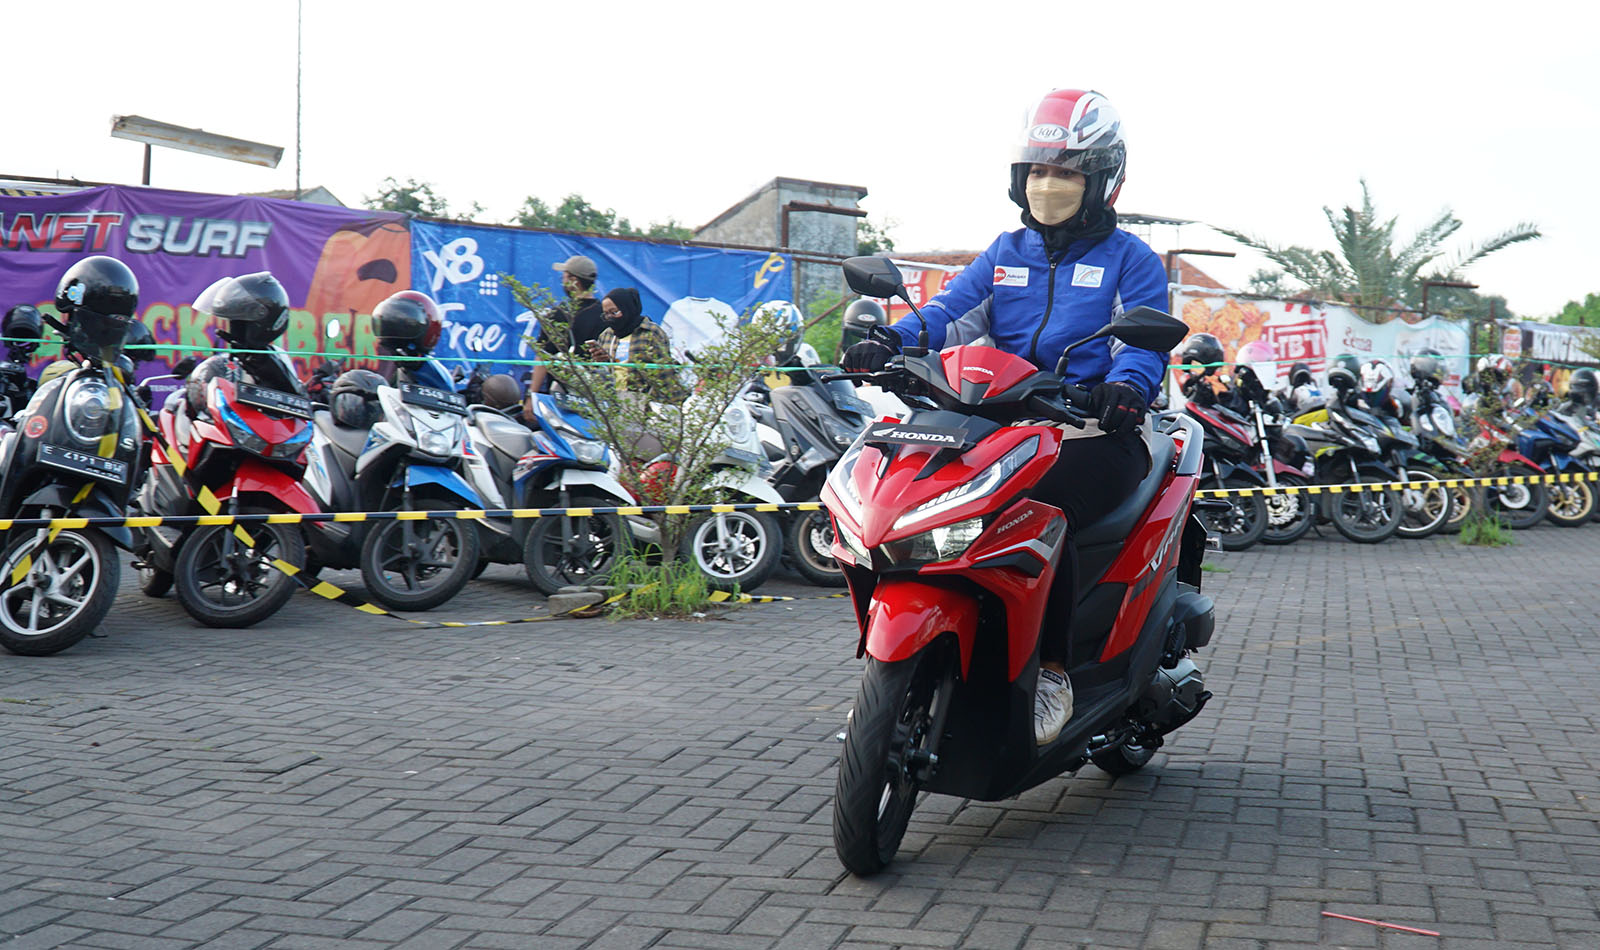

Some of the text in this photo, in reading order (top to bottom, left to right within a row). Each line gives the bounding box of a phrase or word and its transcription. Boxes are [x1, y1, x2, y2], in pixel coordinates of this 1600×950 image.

[0, 211, 273, 257] NET SURF
[962, 366, 994, 377] HONDA
[890, 431, 956, 443] HONDA
[43, 445, 53, 455] E
[996, 509, 1034, 535] HONDA
